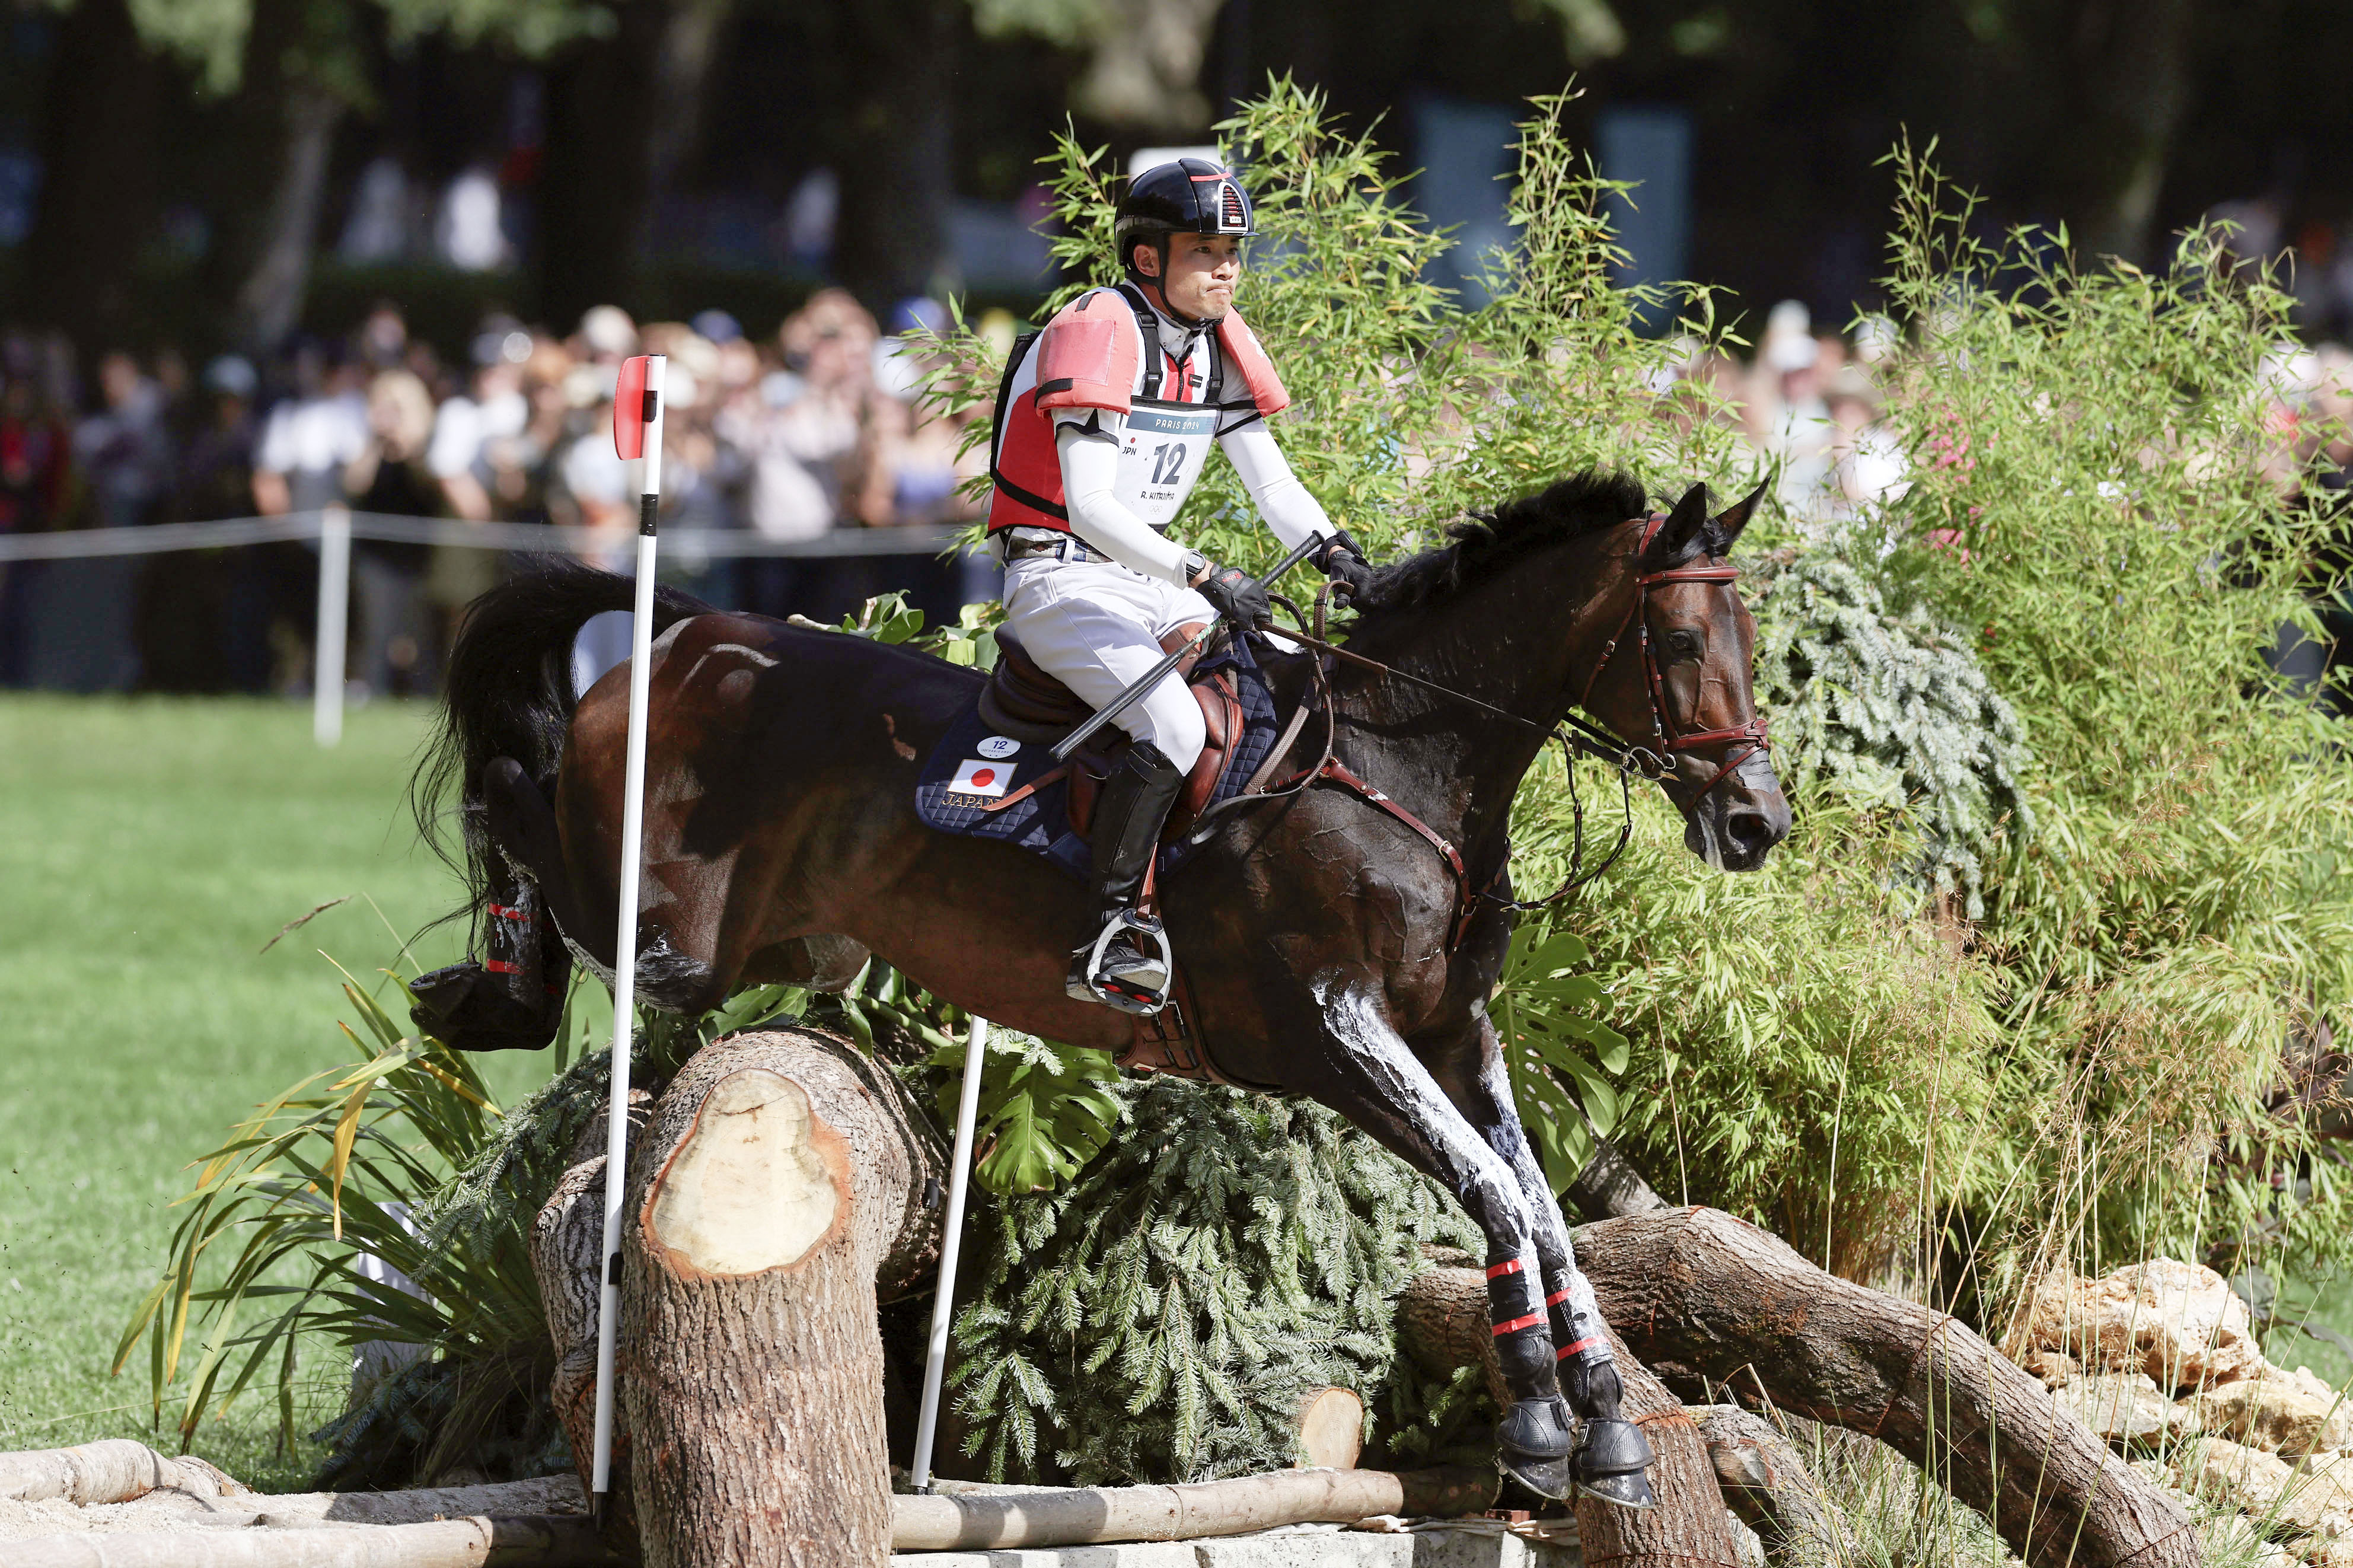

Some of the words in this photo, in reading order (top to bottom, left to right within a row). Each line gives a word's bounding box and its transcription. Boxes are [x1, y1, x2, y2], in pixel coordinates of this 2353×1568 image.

[1182, 420, 1199, 430] 2024
[1123, 447, 1137, 455] JPN
[1151, 442, 1187, 485] 12
[1149, 491, 1175, 501] KITAJIMA
[993, 741, 1007, 749] 12
